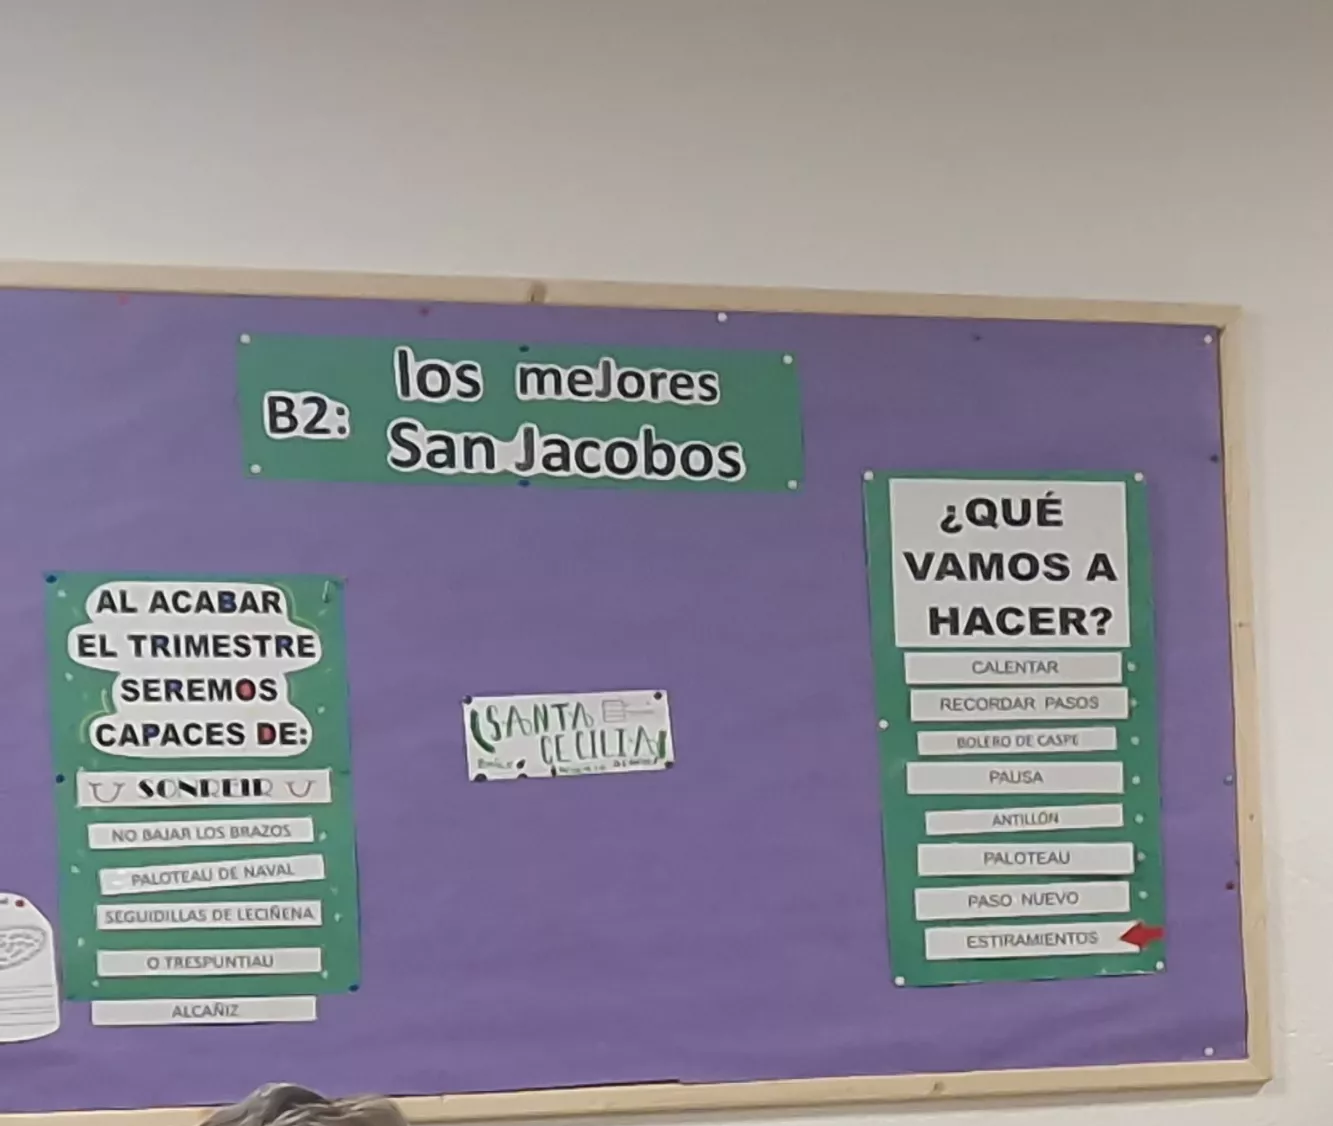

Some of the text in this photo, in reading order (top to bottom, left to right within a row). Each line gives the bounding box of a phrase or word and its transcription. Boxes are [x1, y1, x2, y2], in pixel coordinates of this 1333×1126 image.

[399, 348, 481, 398] los
[267, 396, 347, 435] B2:
[390, 422, 742, 479] San Jacobos
[940, 491, 1064, 533] ¿QUÉ
[903, 552, 1118, 582] VAMOS A
[96, 589, 283, 615] AL ACABAR
[929, 607, 1113, 637] HACER?
[77, 634, 317, 659] EL TRIMESTRE
[972, 660, 1059, 674] CALENTAR
[120, 678, 279, 703] SEREMOS
[940, 695, 1099, 711] RECORDAR PASOS
[486, 701, 594, 742] SANTA
[95, 722, 309, 747] CAPACES DE:
[540, 725, 660, 765] CECILIA
[956, 733, 1080, 749] BOLERO DE CASPE
[989, 770, 1044, 784] PAUSA
[137, 778, 274, 799] SONREIR
[992, 811, 1060, 826] ANTILLÓN
[112, 824, 292, 842] NO BAJAR LOS BRAZOS
[983, 851, 1070, 865] PALOTEAU
[132, 863, 295, 886] PALOTEAU DE NAVAL
[968, 891, 1079, 908] PASO NUEVO
[105, 905, 315, 924] SEGUIDILLAS DE LECIÑENA
[966, 931, 1099, 949] ESTIRAMIENTOS
[146, 955, 273, 970] O TRESPUNTIAU
[172, 1003, 239, 1018] ALCAÑIZ
